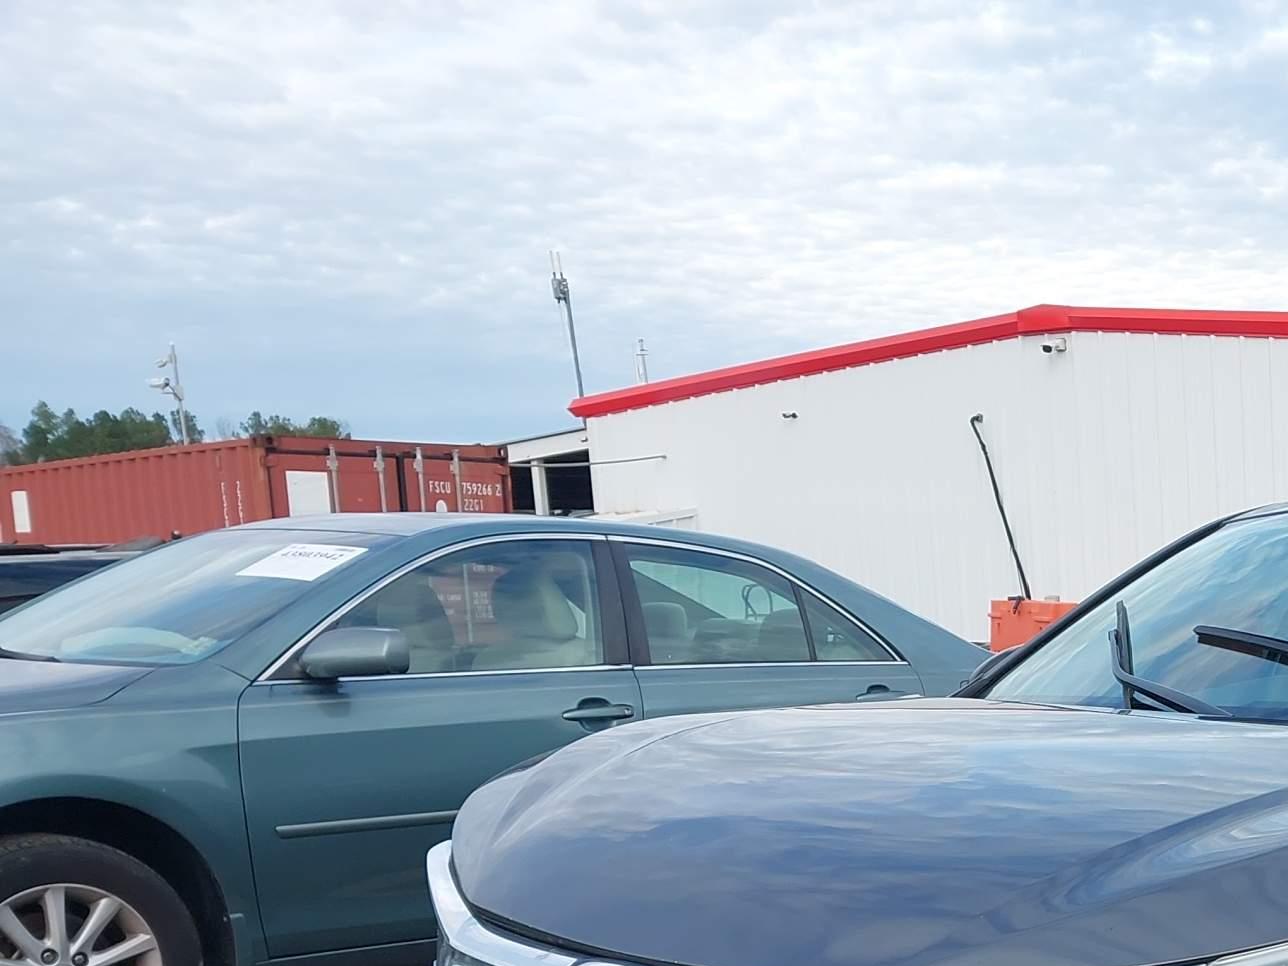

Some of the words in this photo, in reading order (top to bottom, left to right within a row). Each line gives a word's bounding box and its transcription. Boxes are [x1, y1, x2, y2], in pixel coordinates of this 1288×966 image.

[429, 480, 451, 494] FSCU
[462, 482, 492, 496] 759266
[464, 499, 484, 511] 22G1
